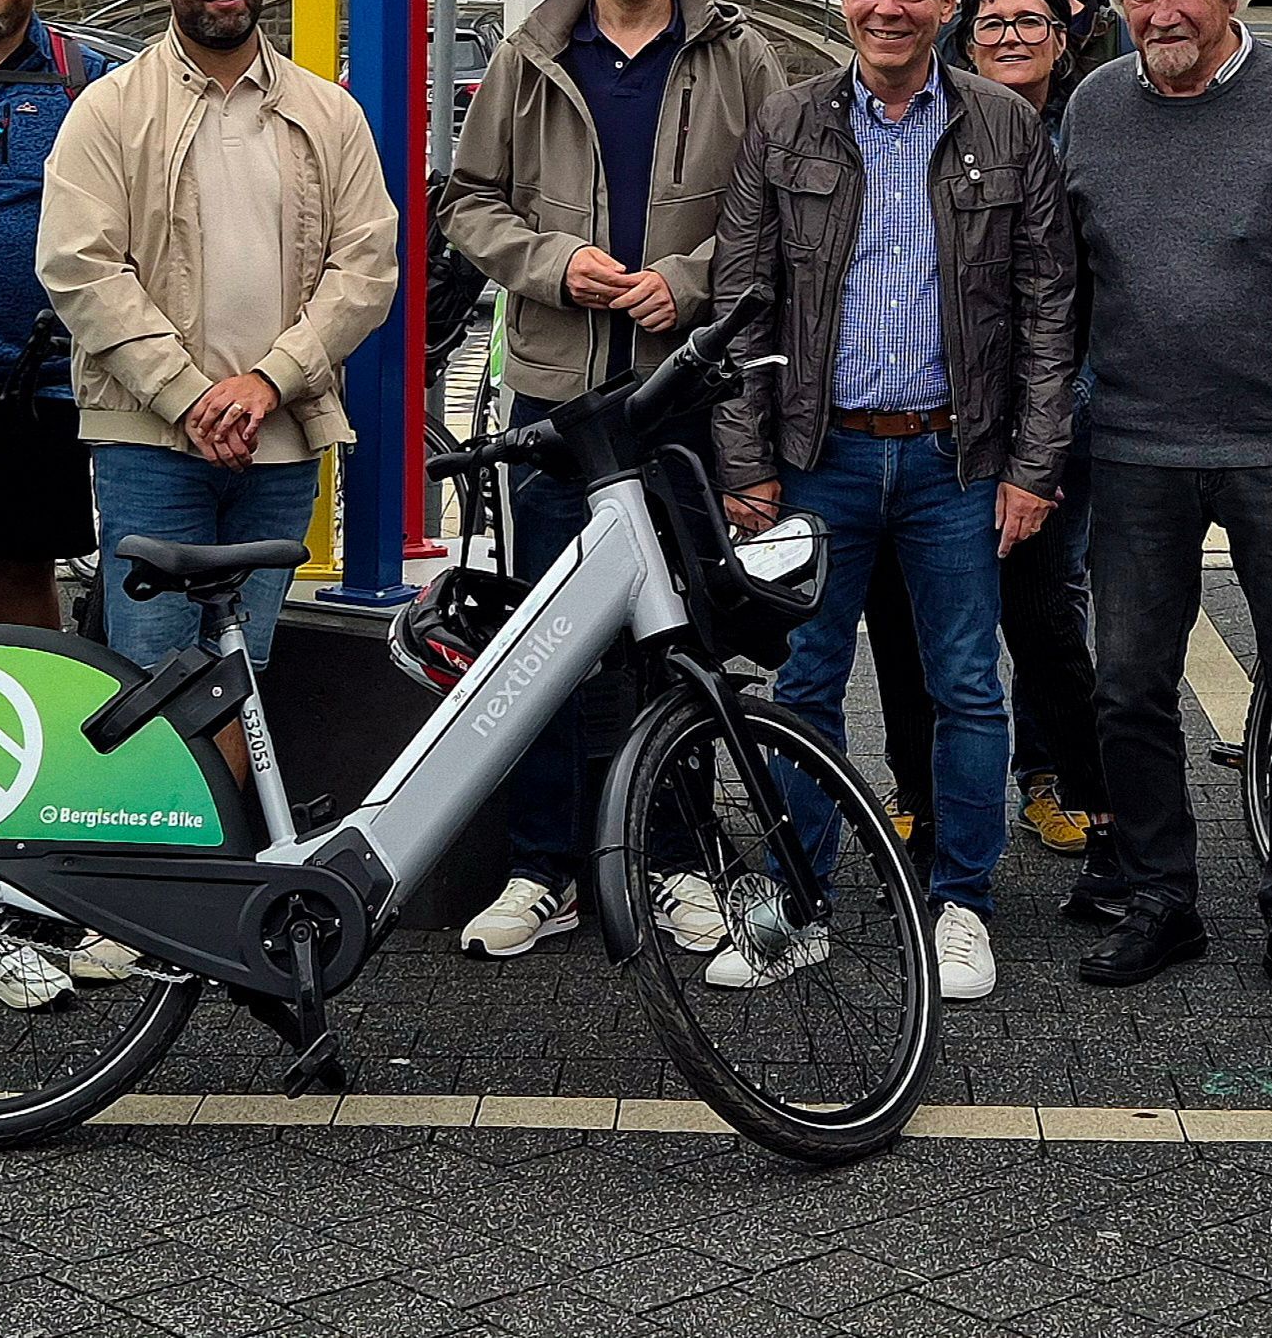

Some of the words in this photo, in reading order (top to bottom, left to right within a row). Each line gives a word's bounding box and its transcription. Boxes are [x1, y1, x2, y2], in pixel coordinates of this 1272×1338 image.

[470, 615, 574, 739] nextbike
[242, 708, 271, 773] 532053
[59, 807, 147, 828] Bergisches
[149, 811, 204, 828] e-Bike
